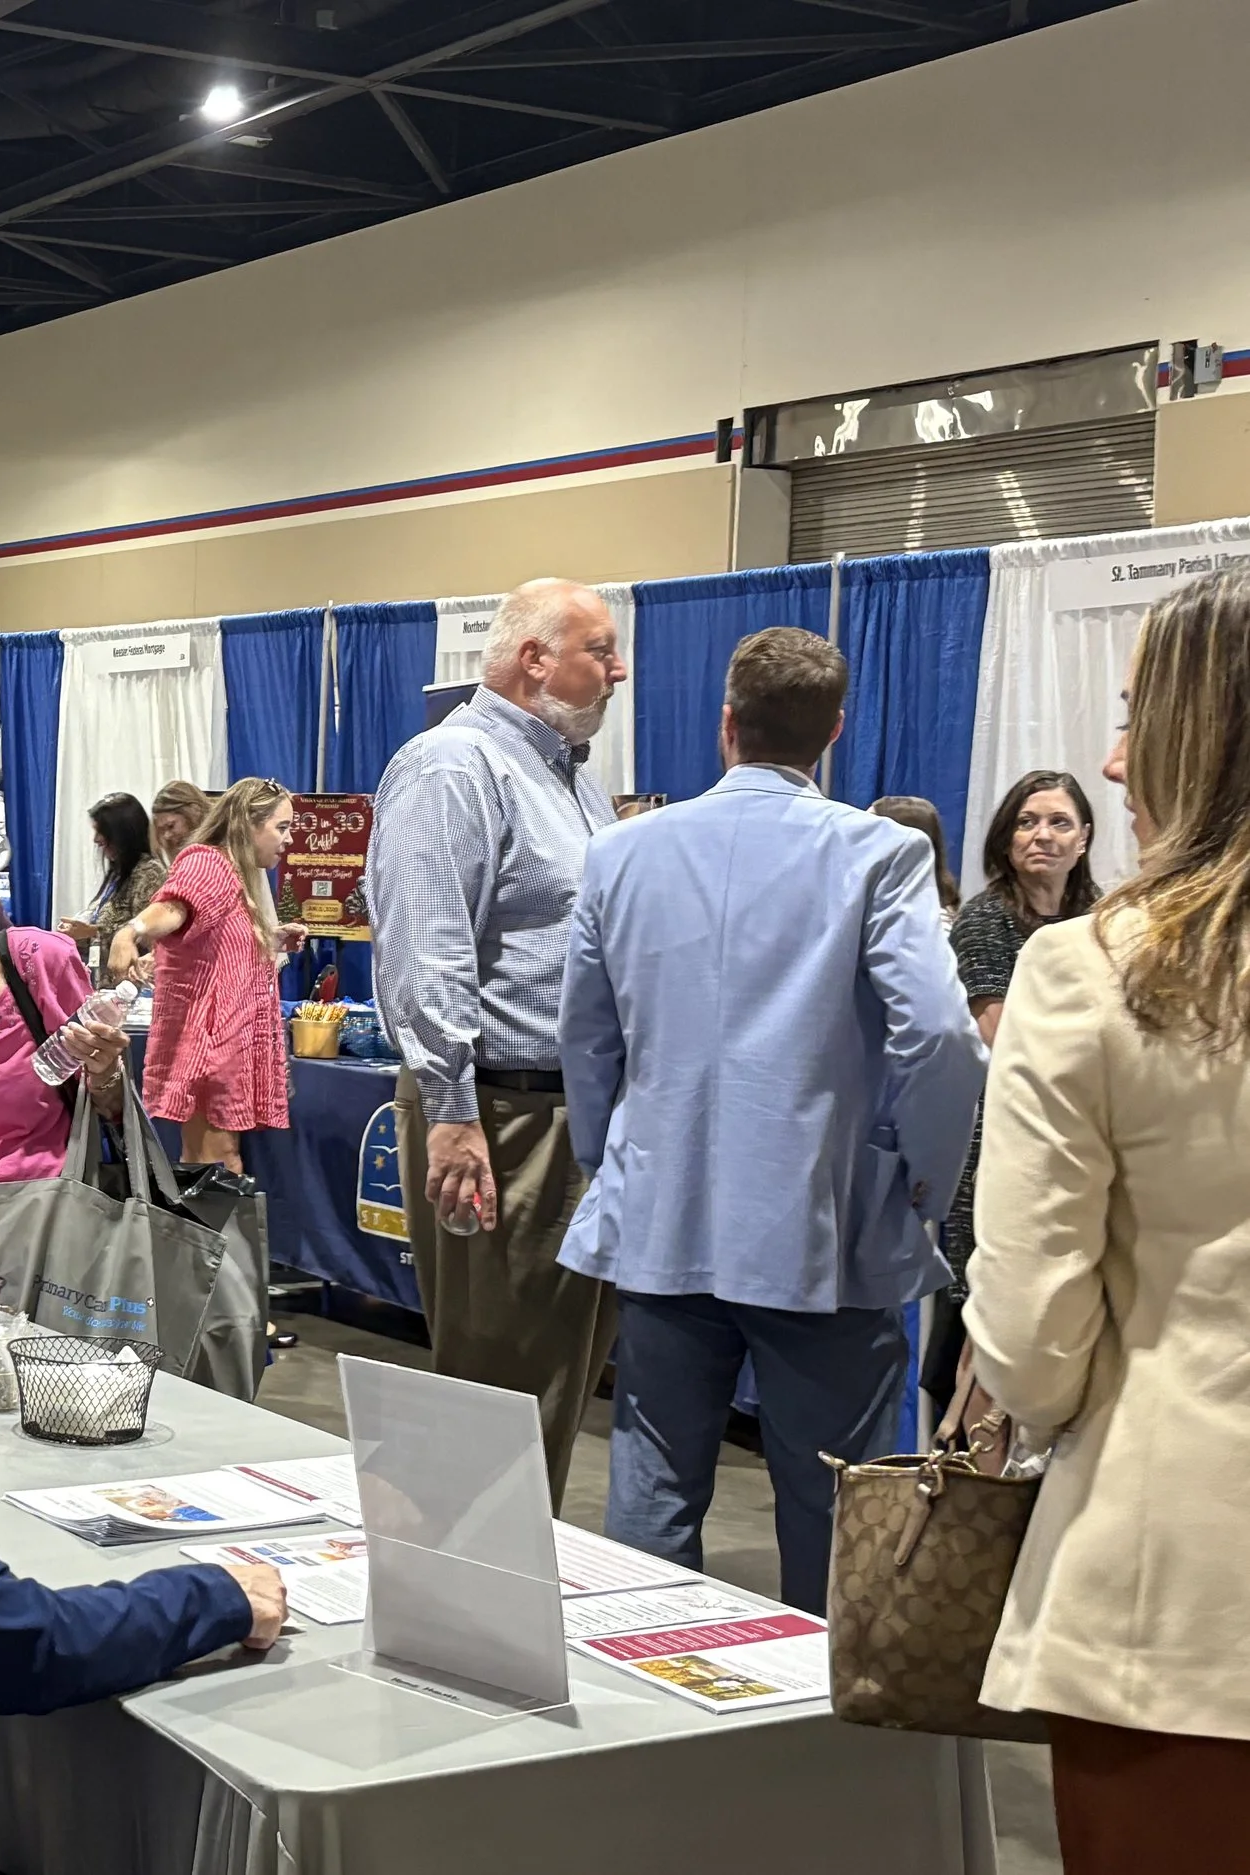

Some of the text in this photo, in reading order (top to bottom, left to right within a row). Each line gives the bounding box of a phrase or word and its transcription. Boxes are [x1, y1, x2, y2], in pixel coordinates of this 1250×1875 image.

[1128, 562, 1177, 580] Tammany
[1178, 555, 1212, 575] Parish
[321, 818, 331, 828] in
[333, 811, 364, 833] 30
[305, 830, 339, 852] Raffle
